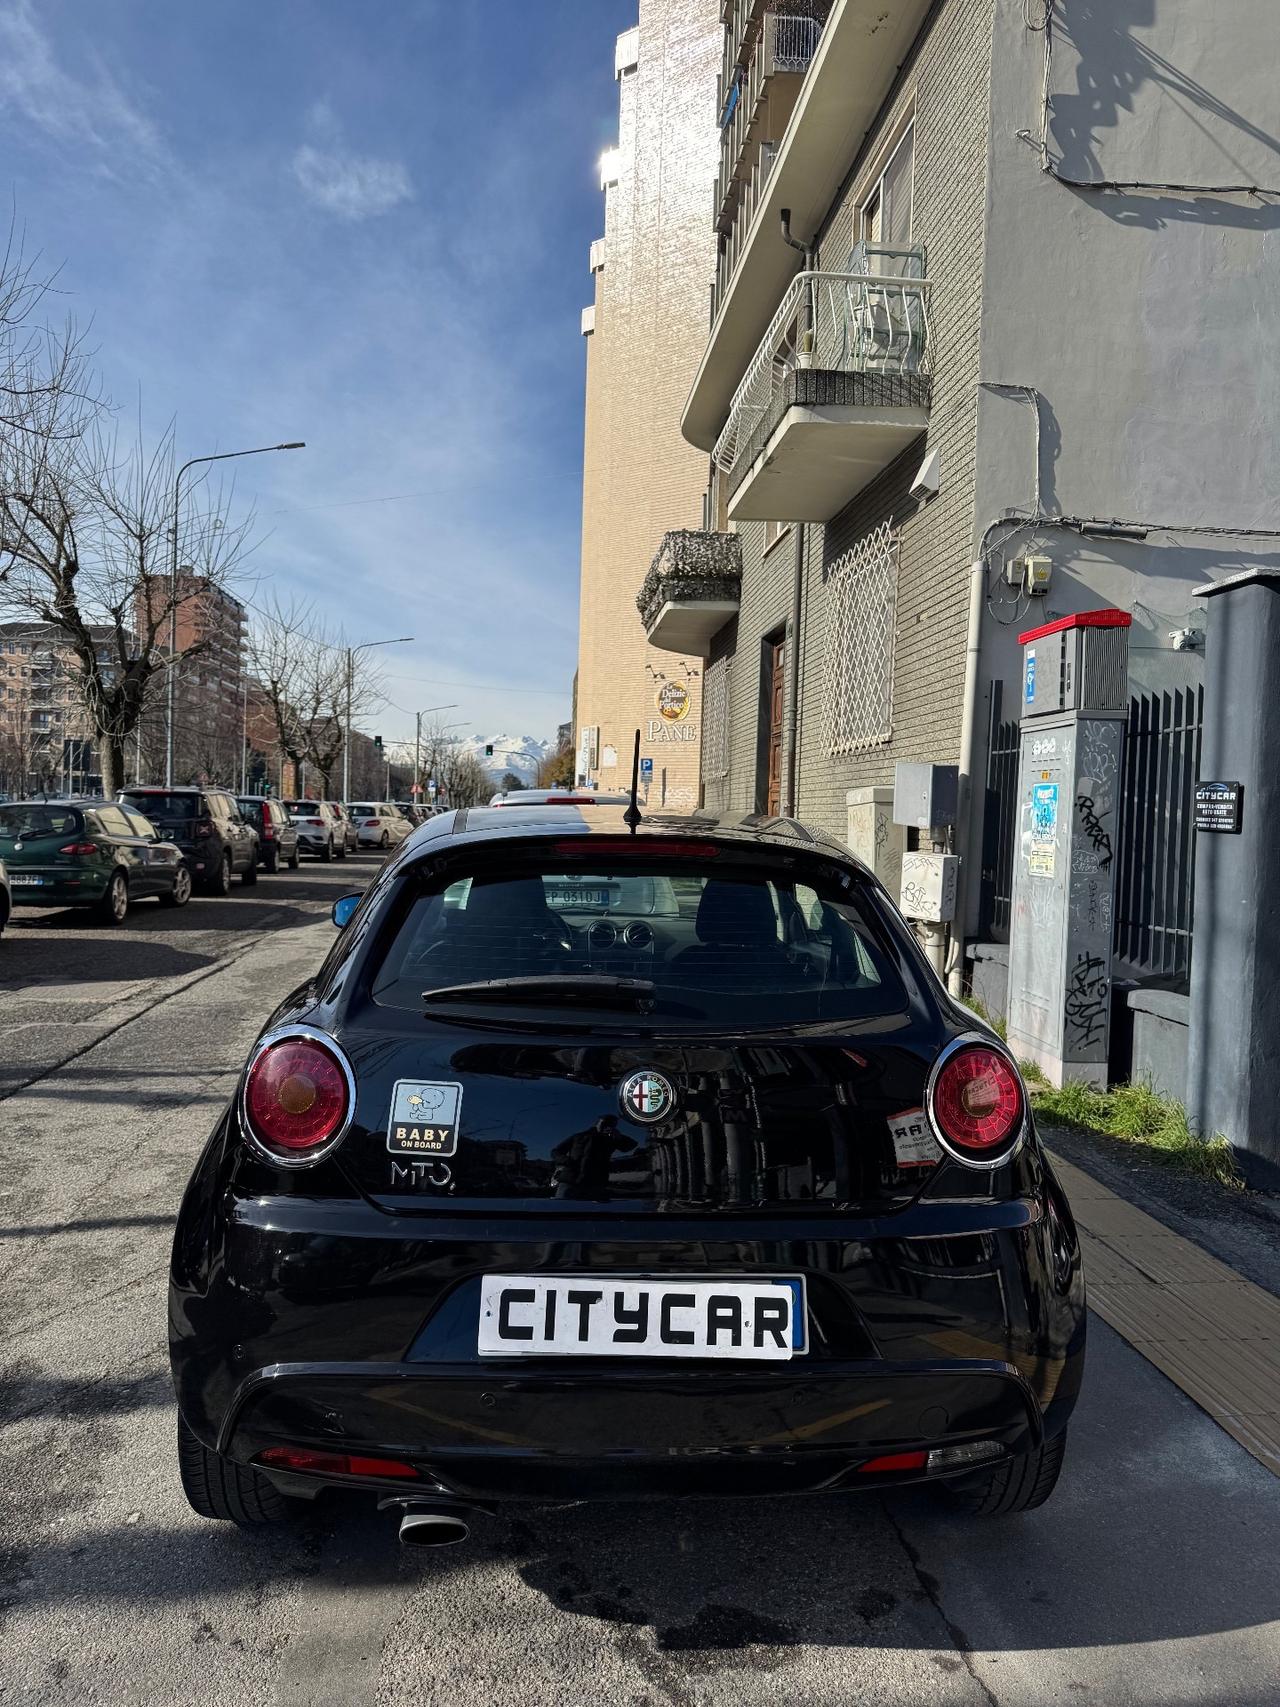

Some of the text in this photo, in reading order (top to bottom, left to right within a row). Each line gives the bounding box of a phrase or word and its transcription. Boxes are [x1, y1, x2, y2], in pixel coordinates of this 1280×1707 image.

[646, 720, 697, 742] PANE
[643, 760, 651, 769] P
[1196, 792, 1236, 800] CITYCAR
[627, 1075, 669, 1097] ALFA ROMEO
[396, 1127, 449, 1141] BABY
[401, 1140, 442, 1150] ON BOARD
[498, 1288, 789, 1348] CITYCAR
